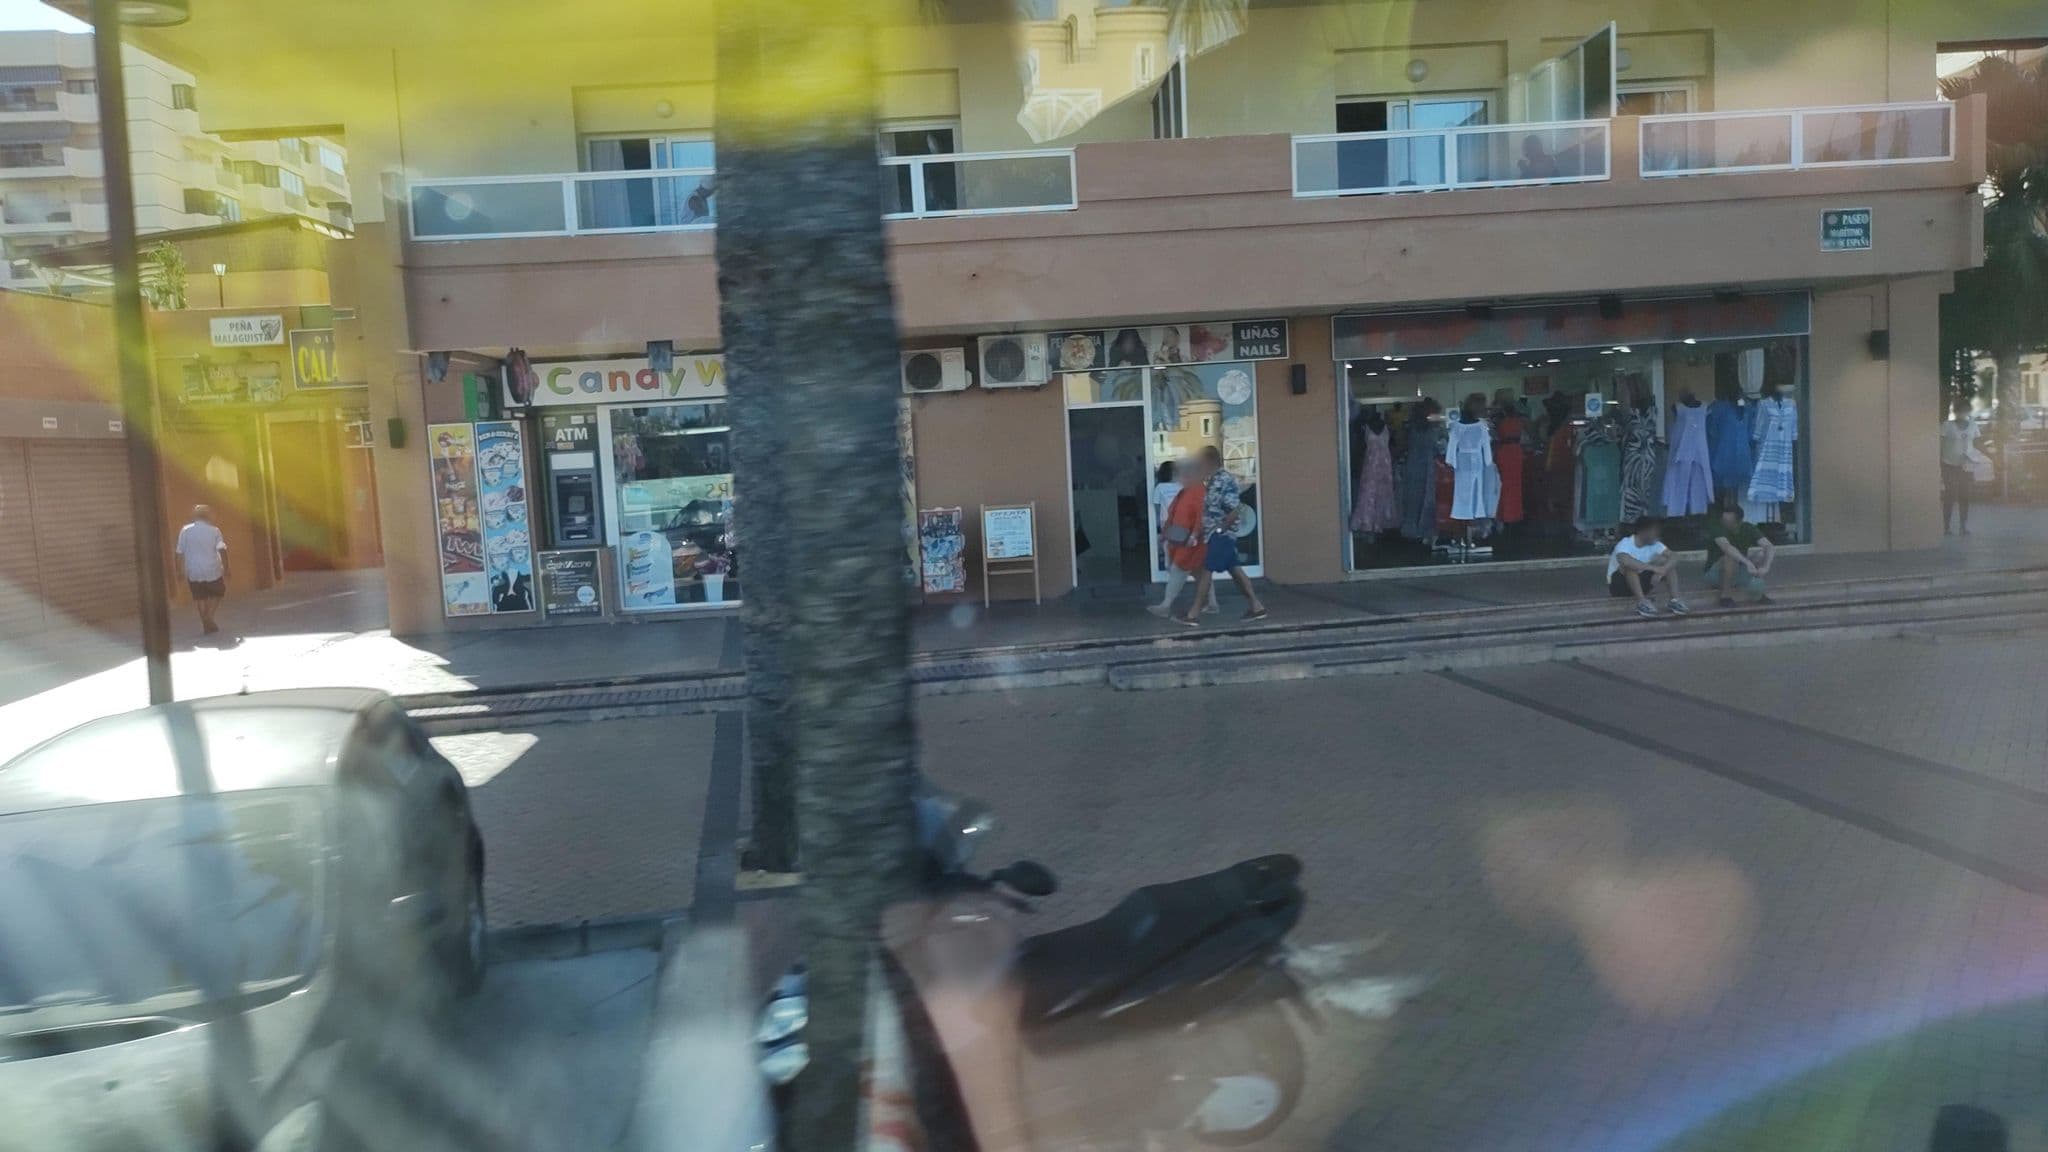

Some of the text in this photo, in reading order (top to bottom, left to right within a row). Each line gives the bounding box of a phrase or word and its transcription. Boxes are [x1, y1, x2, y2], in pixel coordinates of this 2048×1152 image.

[1842, 213, 1869, 225] PASEO
[229, 319, 253, 331] PEÑA
[1240, 325, 1280, 340] UÑAS
[1239, 344, 1281, 357] NAILS
[547, 366, 686, 396] Candy
[555, 427, 588, 442] ATM
